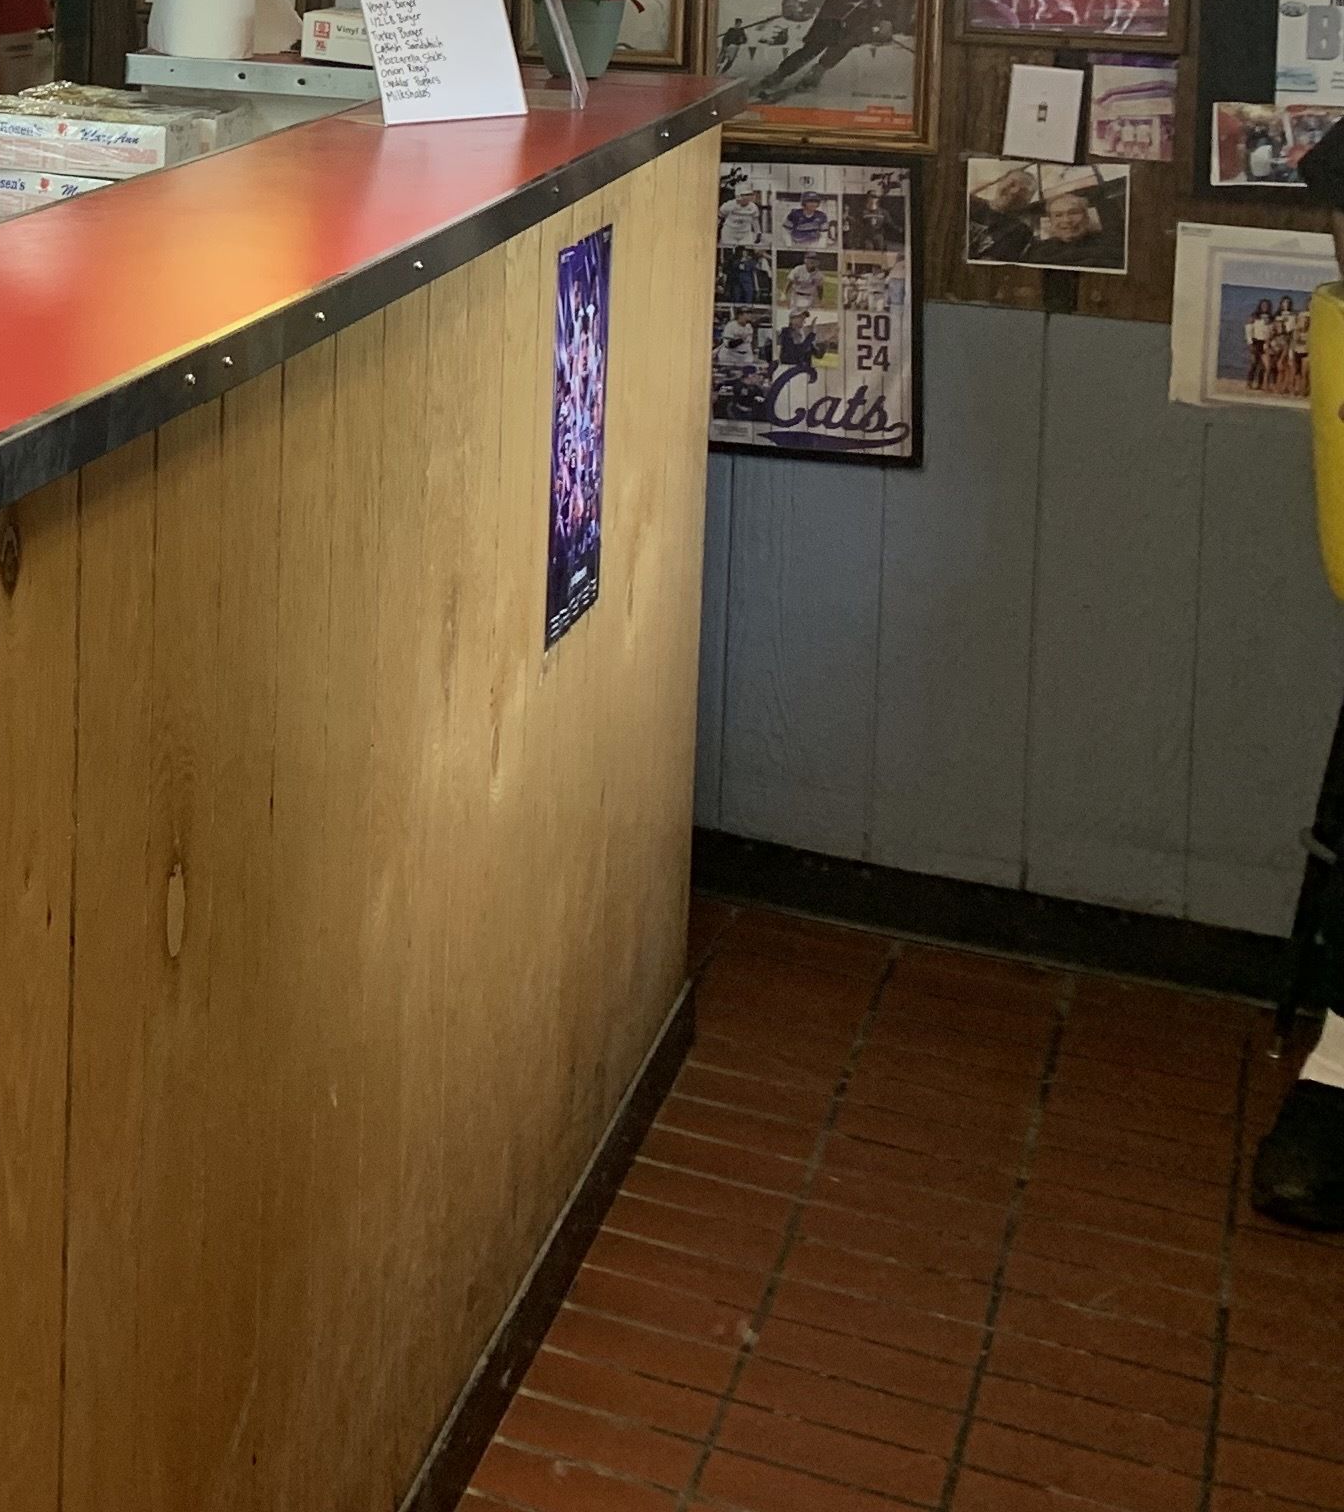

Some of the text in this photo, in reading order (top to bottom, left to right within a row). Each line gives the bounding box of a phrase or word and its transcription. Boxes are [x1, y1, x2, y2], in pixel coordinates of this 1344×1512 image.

[396, 13, 422, 26] Burger
[336, 24, 359, 36] Vinyl
[380, 67, 405, 78] Onion
[114, 133, 140, 145] Ann
[856, 314, 891, 342] 20
[856, 344, 891, 372] 24
[766, 361, 906, 434] Cats
